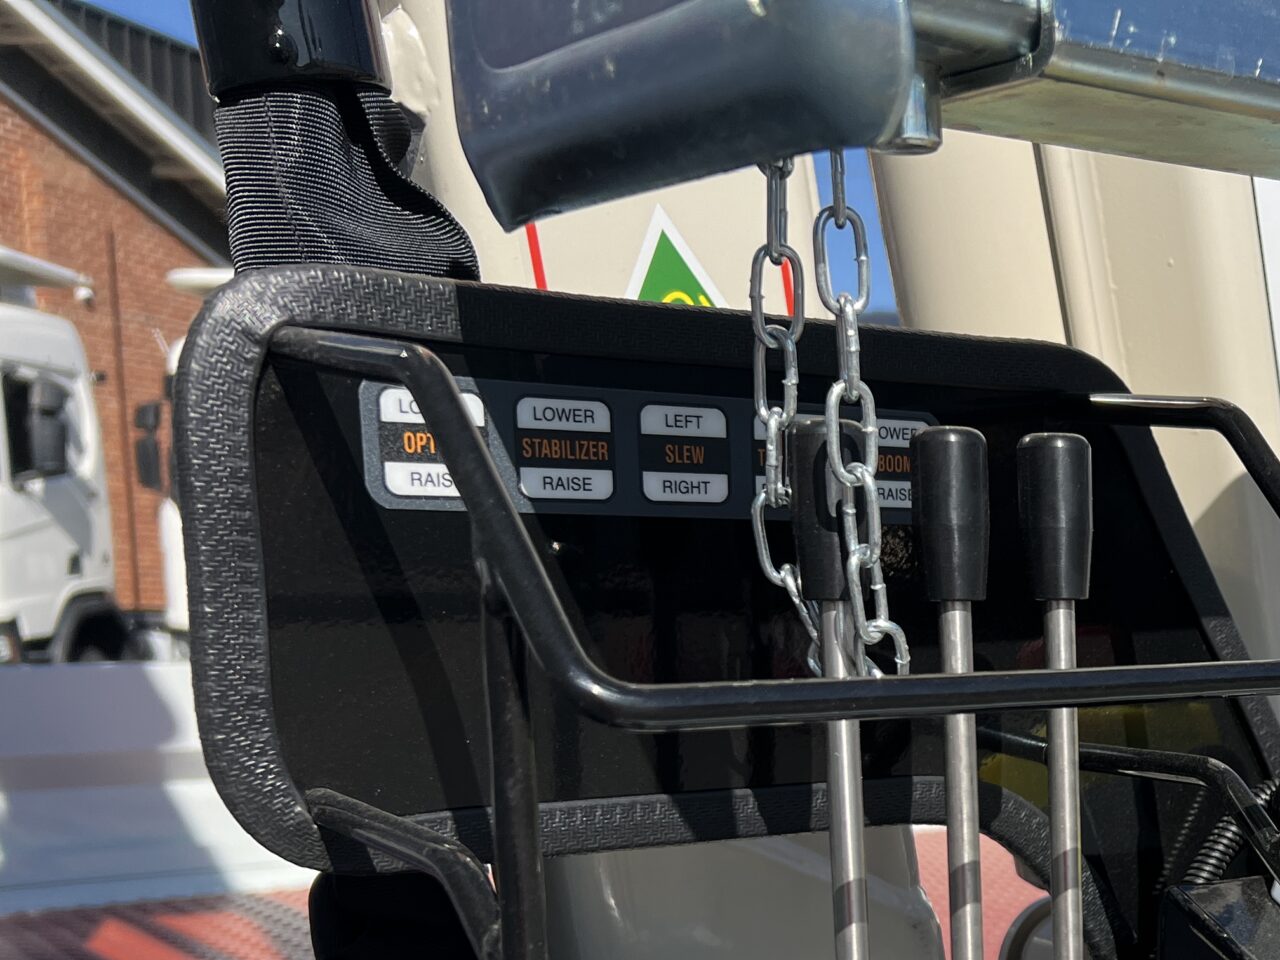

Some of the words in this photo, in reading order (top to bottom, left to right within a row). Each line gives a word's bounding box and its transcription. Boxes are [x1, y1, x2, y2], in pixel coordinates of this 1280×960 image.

[533, 405, 595, 424] LOWER
[664, 414, 703, 431] LEFT
[879, 425, 917, 441] OWE
[522, 438, 608, 461] STABILIZER
[665, 444, 704, 465] SLEW
[410, 471, 453, 488] RAIS
[542, 475, 593, 493] RAISE
[662, 479, 710, 497] RIGHT
